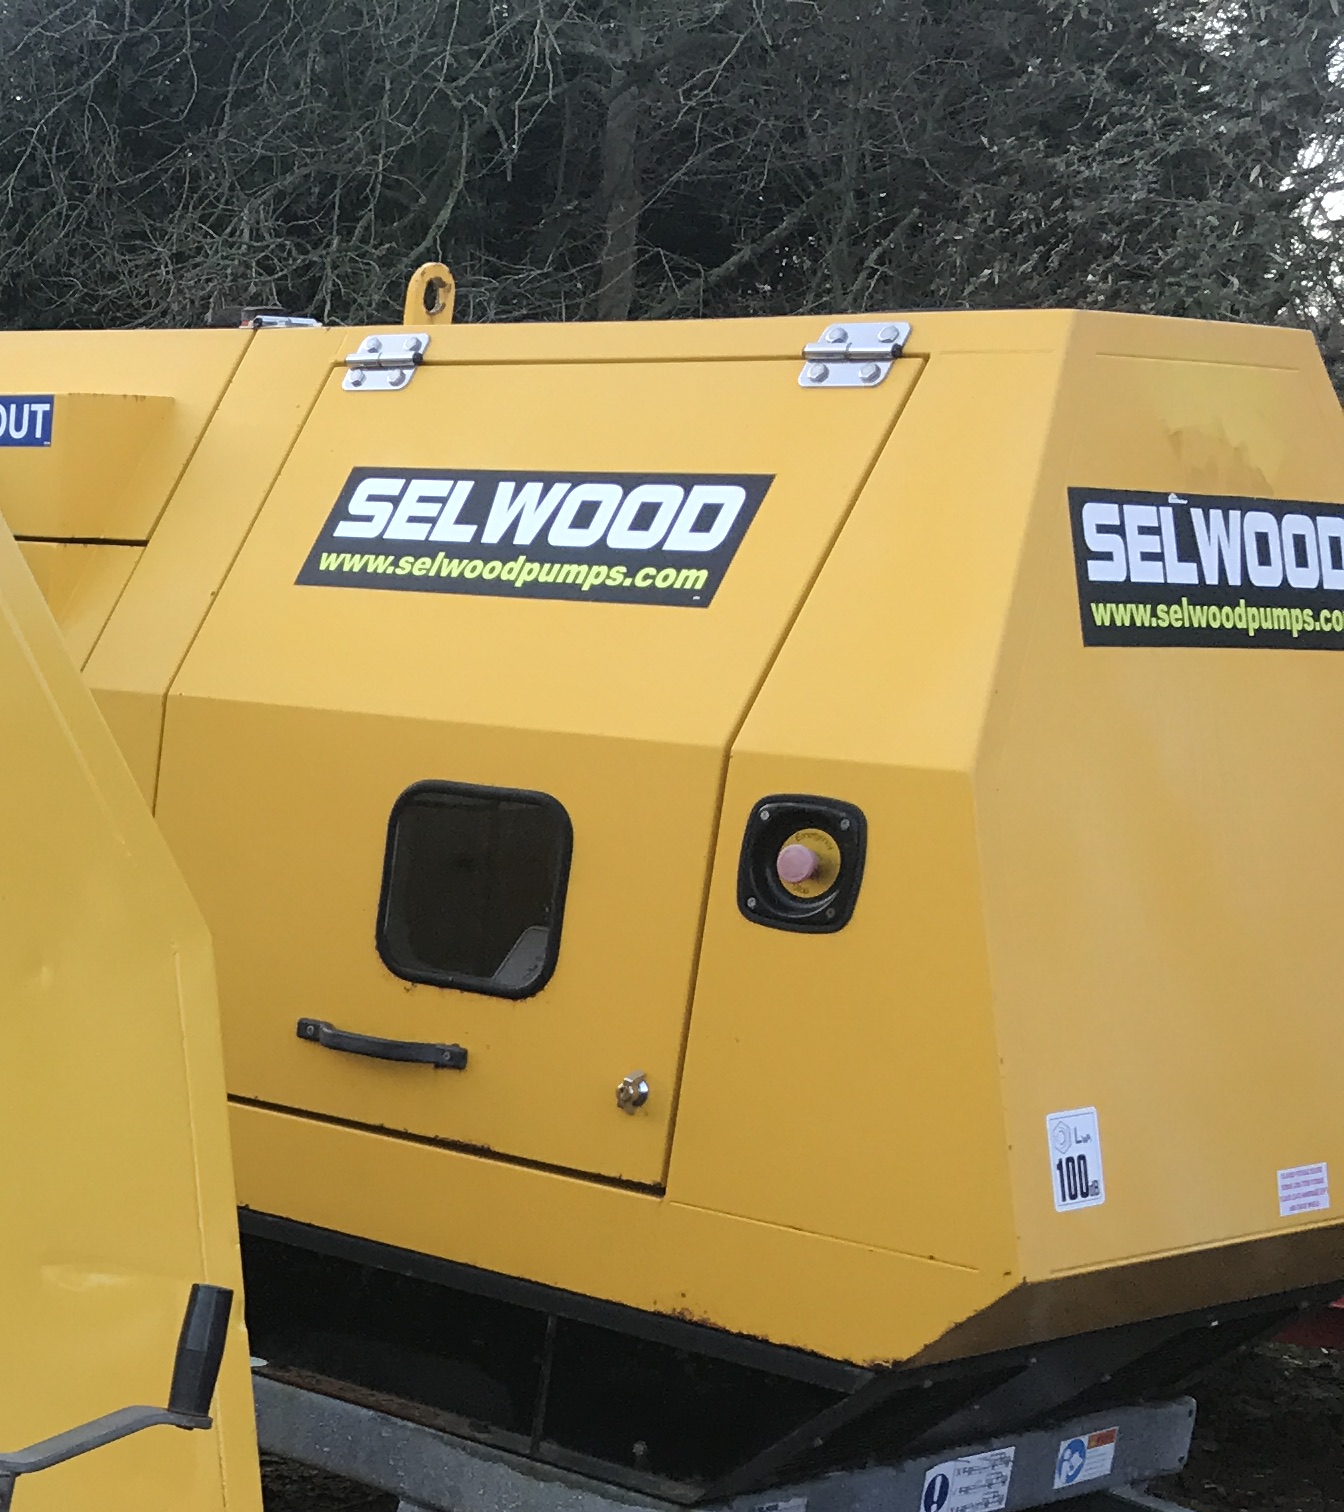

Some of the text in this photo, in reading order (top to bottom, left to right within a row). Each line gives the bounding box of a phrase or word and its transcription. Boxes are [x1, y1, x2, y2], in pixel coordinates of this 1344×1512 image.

[333, 477, 747, 552] SELWOOD
[319, 551, 709, 591] www.selwoodpumps.com
[1082, 502, 1344, 590] SELWOOD
[1090, 597, 1344, 637] www.selwoodpumps.co
